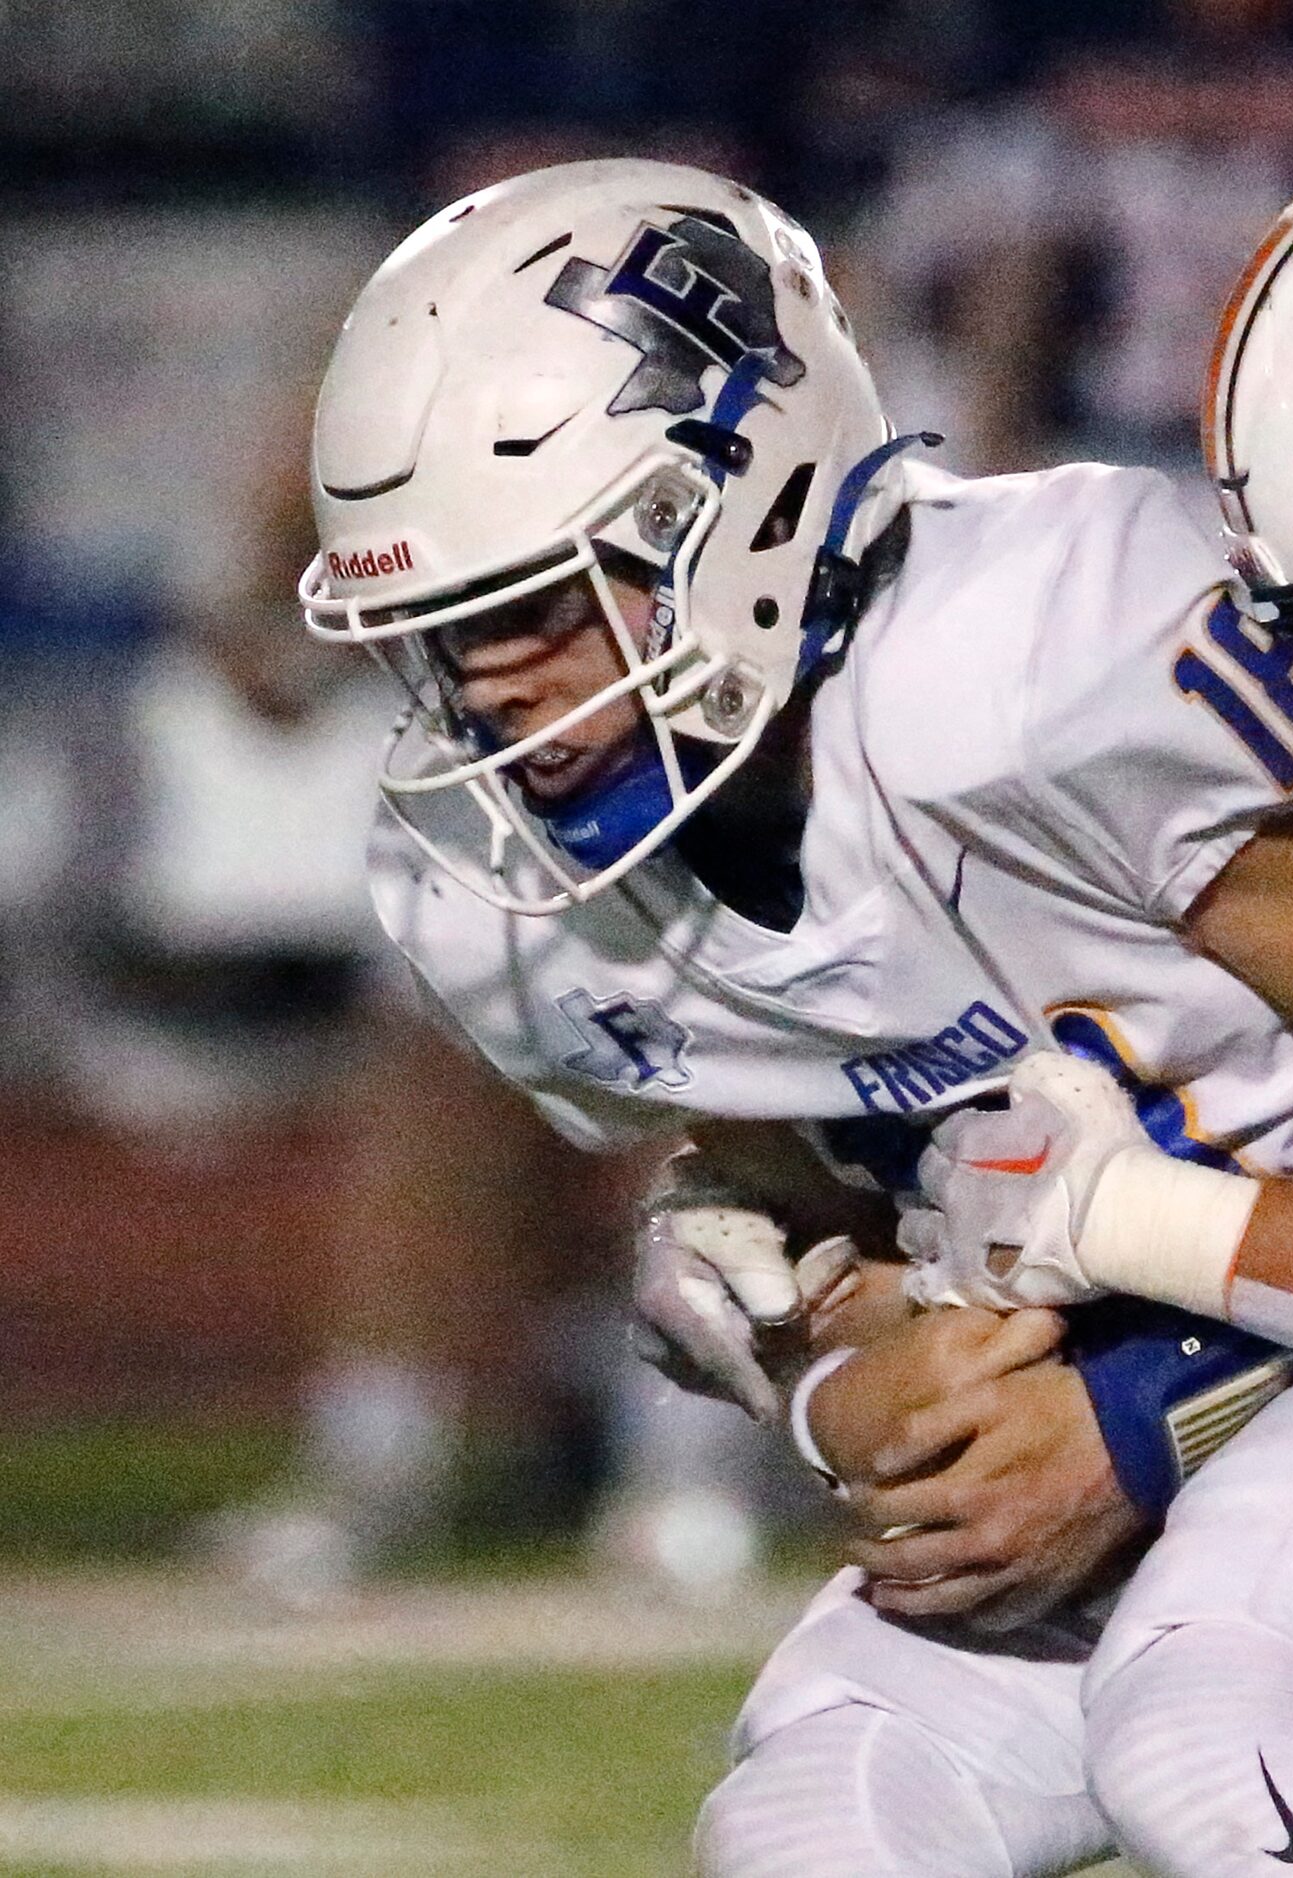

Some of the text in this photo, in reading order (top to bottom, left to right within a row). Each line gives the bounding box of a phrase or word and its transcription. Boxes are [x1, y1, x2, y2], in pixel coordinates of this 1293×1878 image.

[604, 220, 768, 373] F
[328, 541, 413, 579] Riddell
[588, 1002, 663, 1081] F
[840, 1001, 1029, 1113] FRISCO
